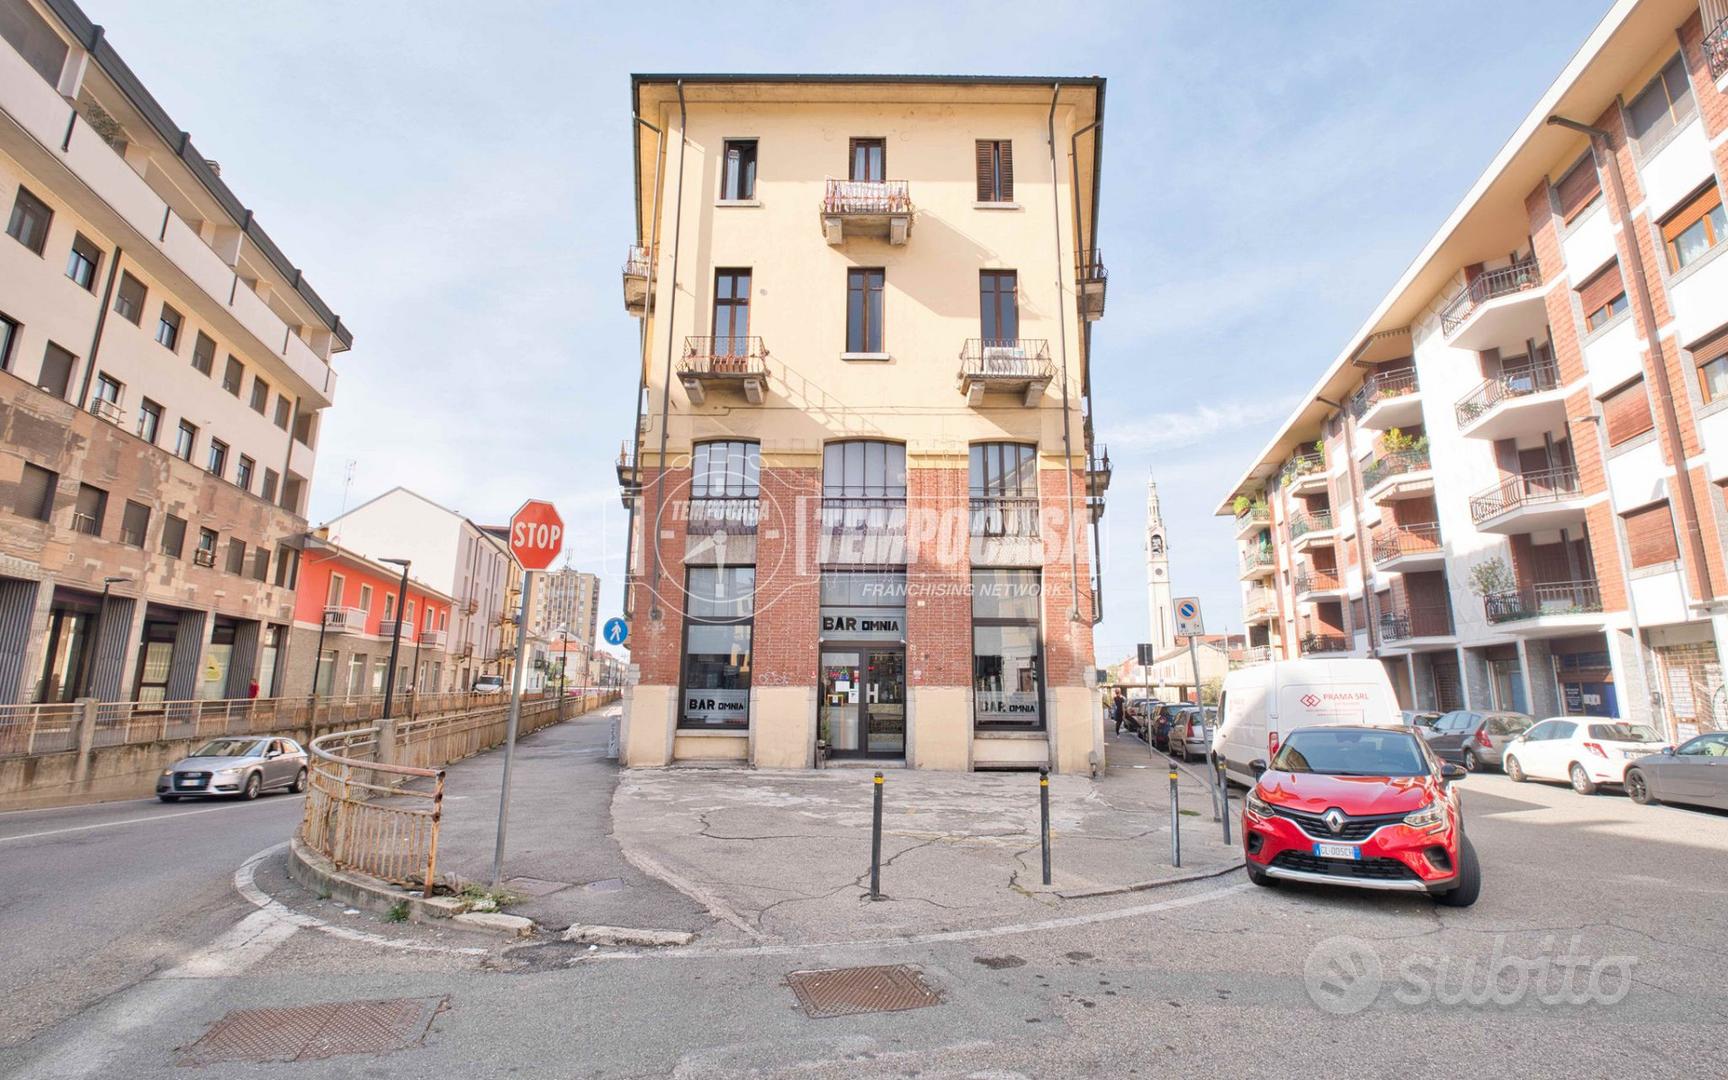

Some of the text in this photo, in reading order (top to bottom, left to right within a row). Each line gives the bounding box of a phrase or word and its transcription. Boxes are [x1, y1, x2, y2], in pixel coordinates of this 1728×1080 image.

[513, 521, 561, 550] STOP
[823, 616, 899, 631] BAR OMNIA
[689, 698, 744, 710] BAR OMNIA
[1009, 704, 1035, 713] OMNIA
